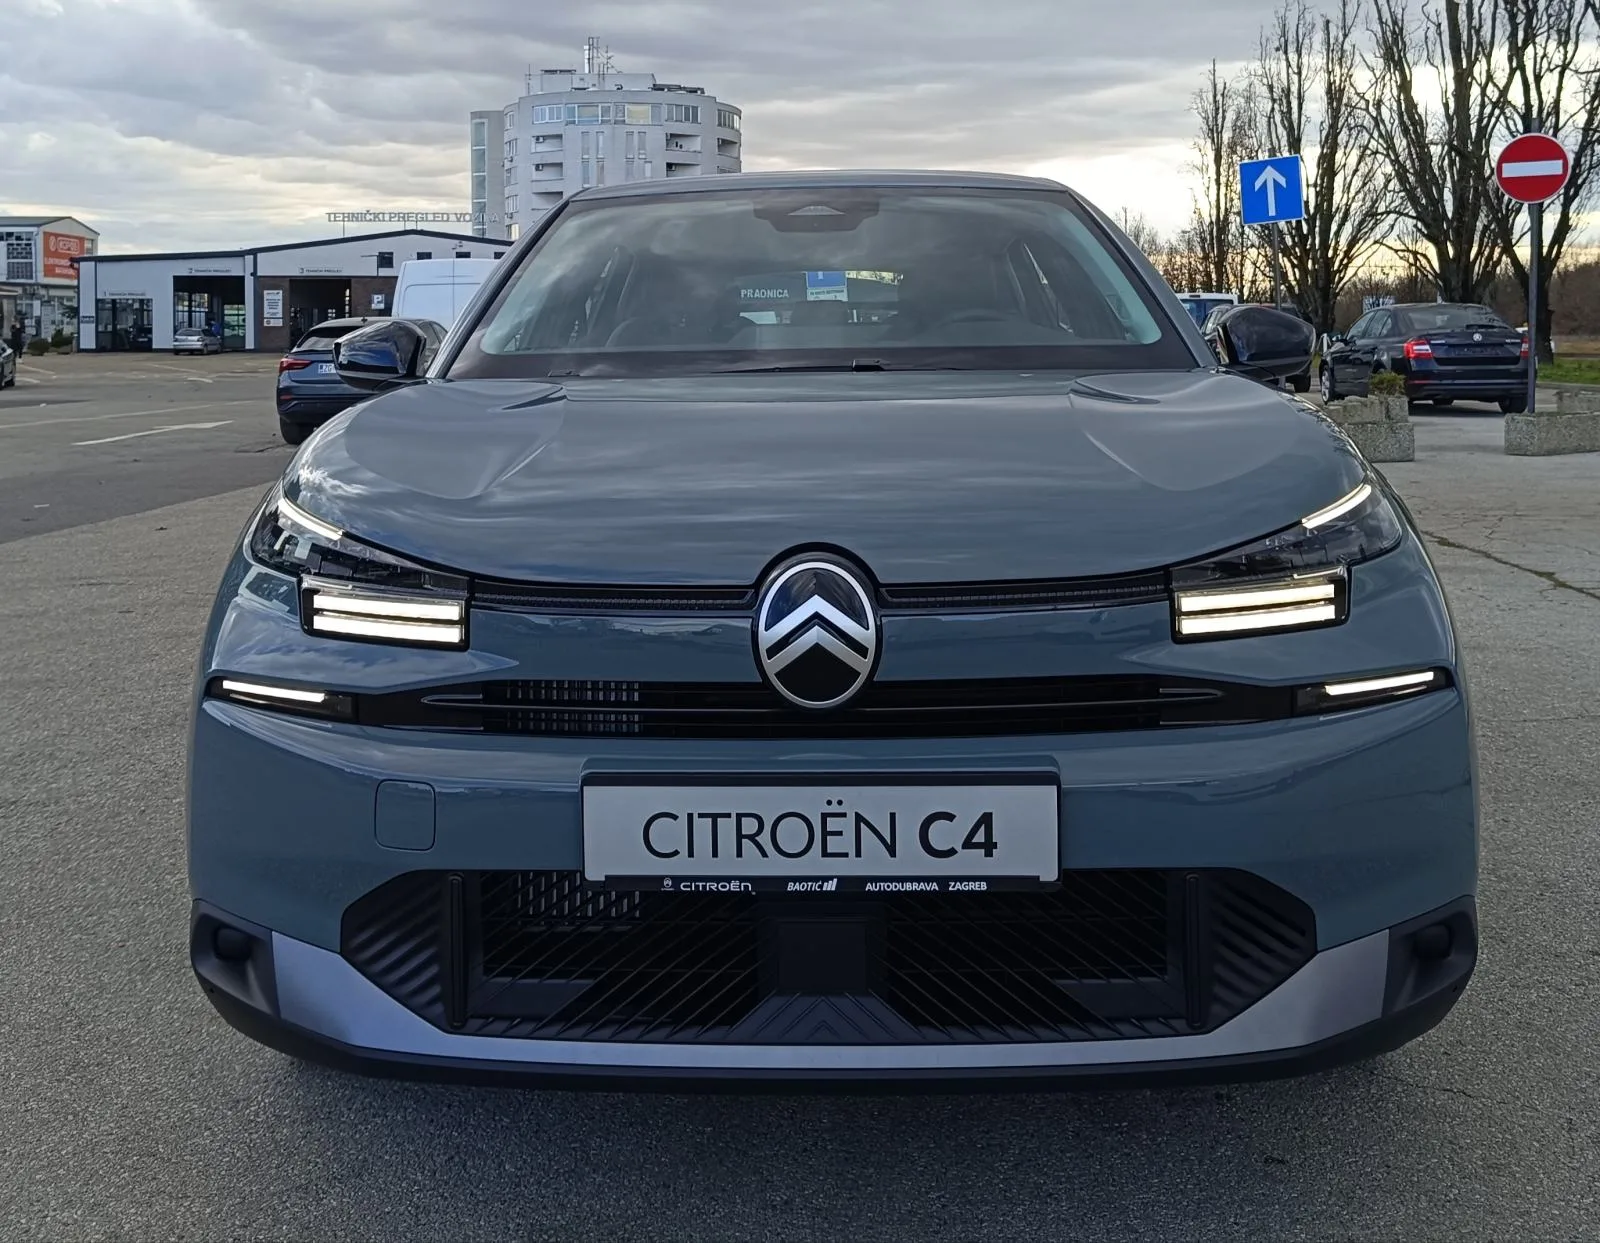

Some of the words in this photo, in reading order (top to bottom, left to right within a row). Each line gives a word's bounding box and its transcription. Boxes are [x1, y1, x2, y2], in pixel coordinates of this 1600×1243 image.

[326, 210, 386, 223] TEHNIČKI
[388, 212, 450, 223] PREGLED
[740, 288, 789, 299] PRAONICA
[642, 798, 897, 859] CITROËN
[918, 811, 998, 859] C4
[787, 880, 822, 892] BAOTIĆ
[865, 881, 939, 892] AUTODUBRAVA
[948, 881, 988, 892] ZAGREB
